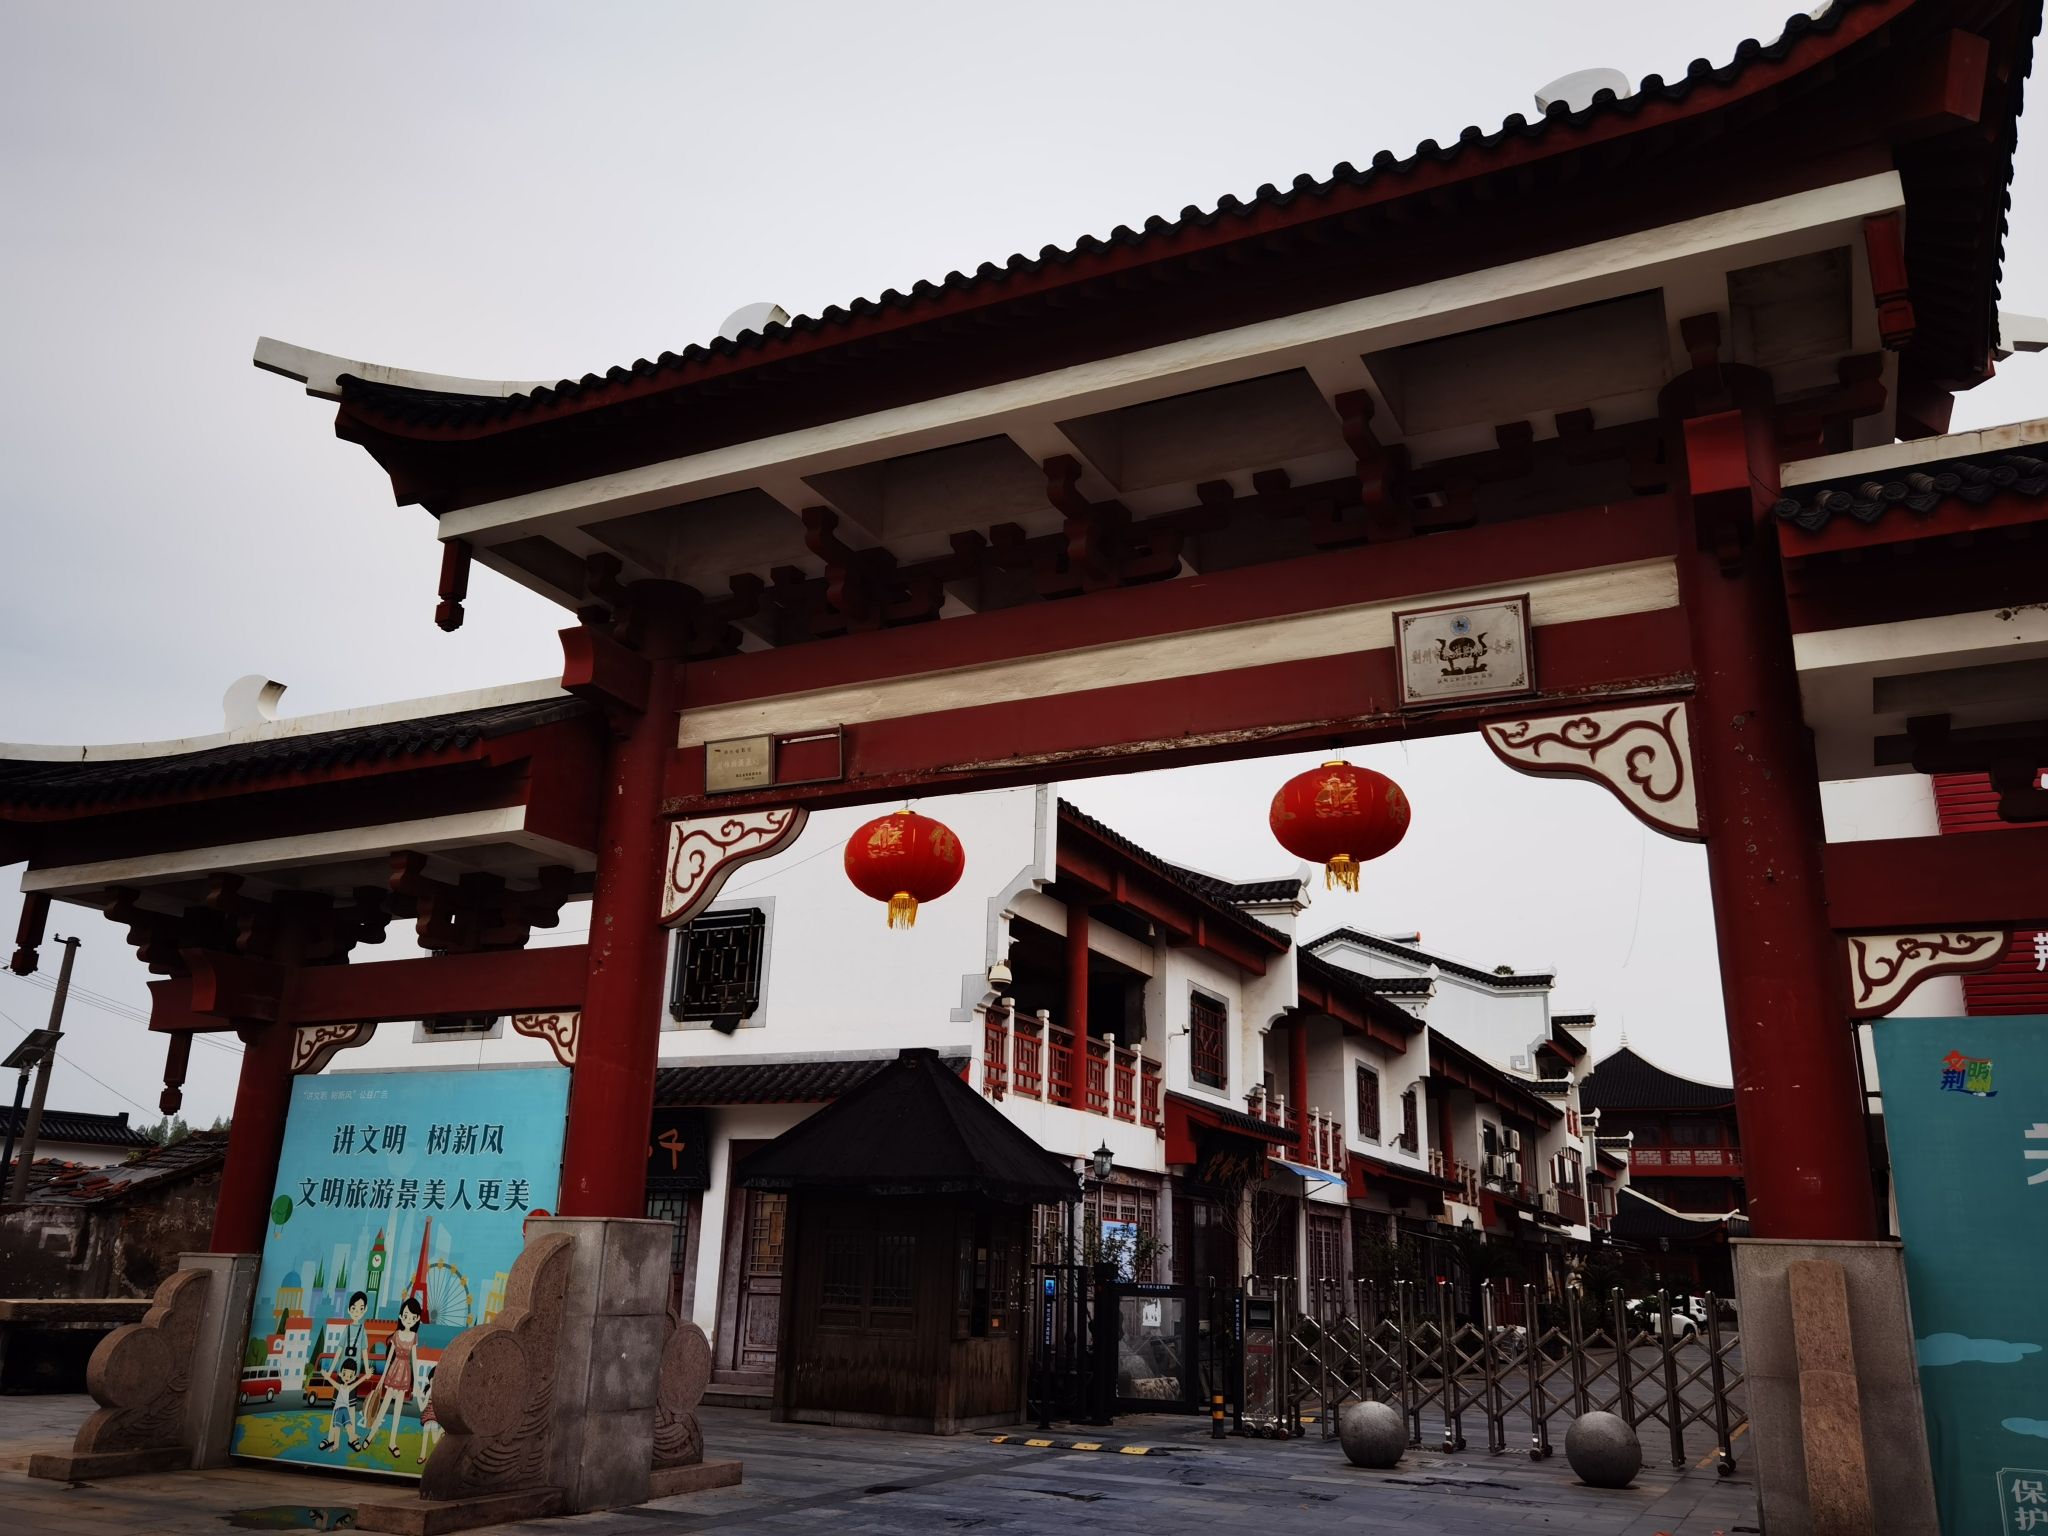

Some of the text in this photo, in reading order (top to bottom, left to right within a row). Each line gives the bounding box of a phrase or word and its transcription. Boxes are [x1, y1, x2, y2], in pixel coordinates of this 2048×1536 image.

[332, 1123, 505, 1155] 讲文明 树新风
[296, 1177, 530, 1212] 文明旅游景美人更美
[2010, 1478, 2048, 1536] 保护
